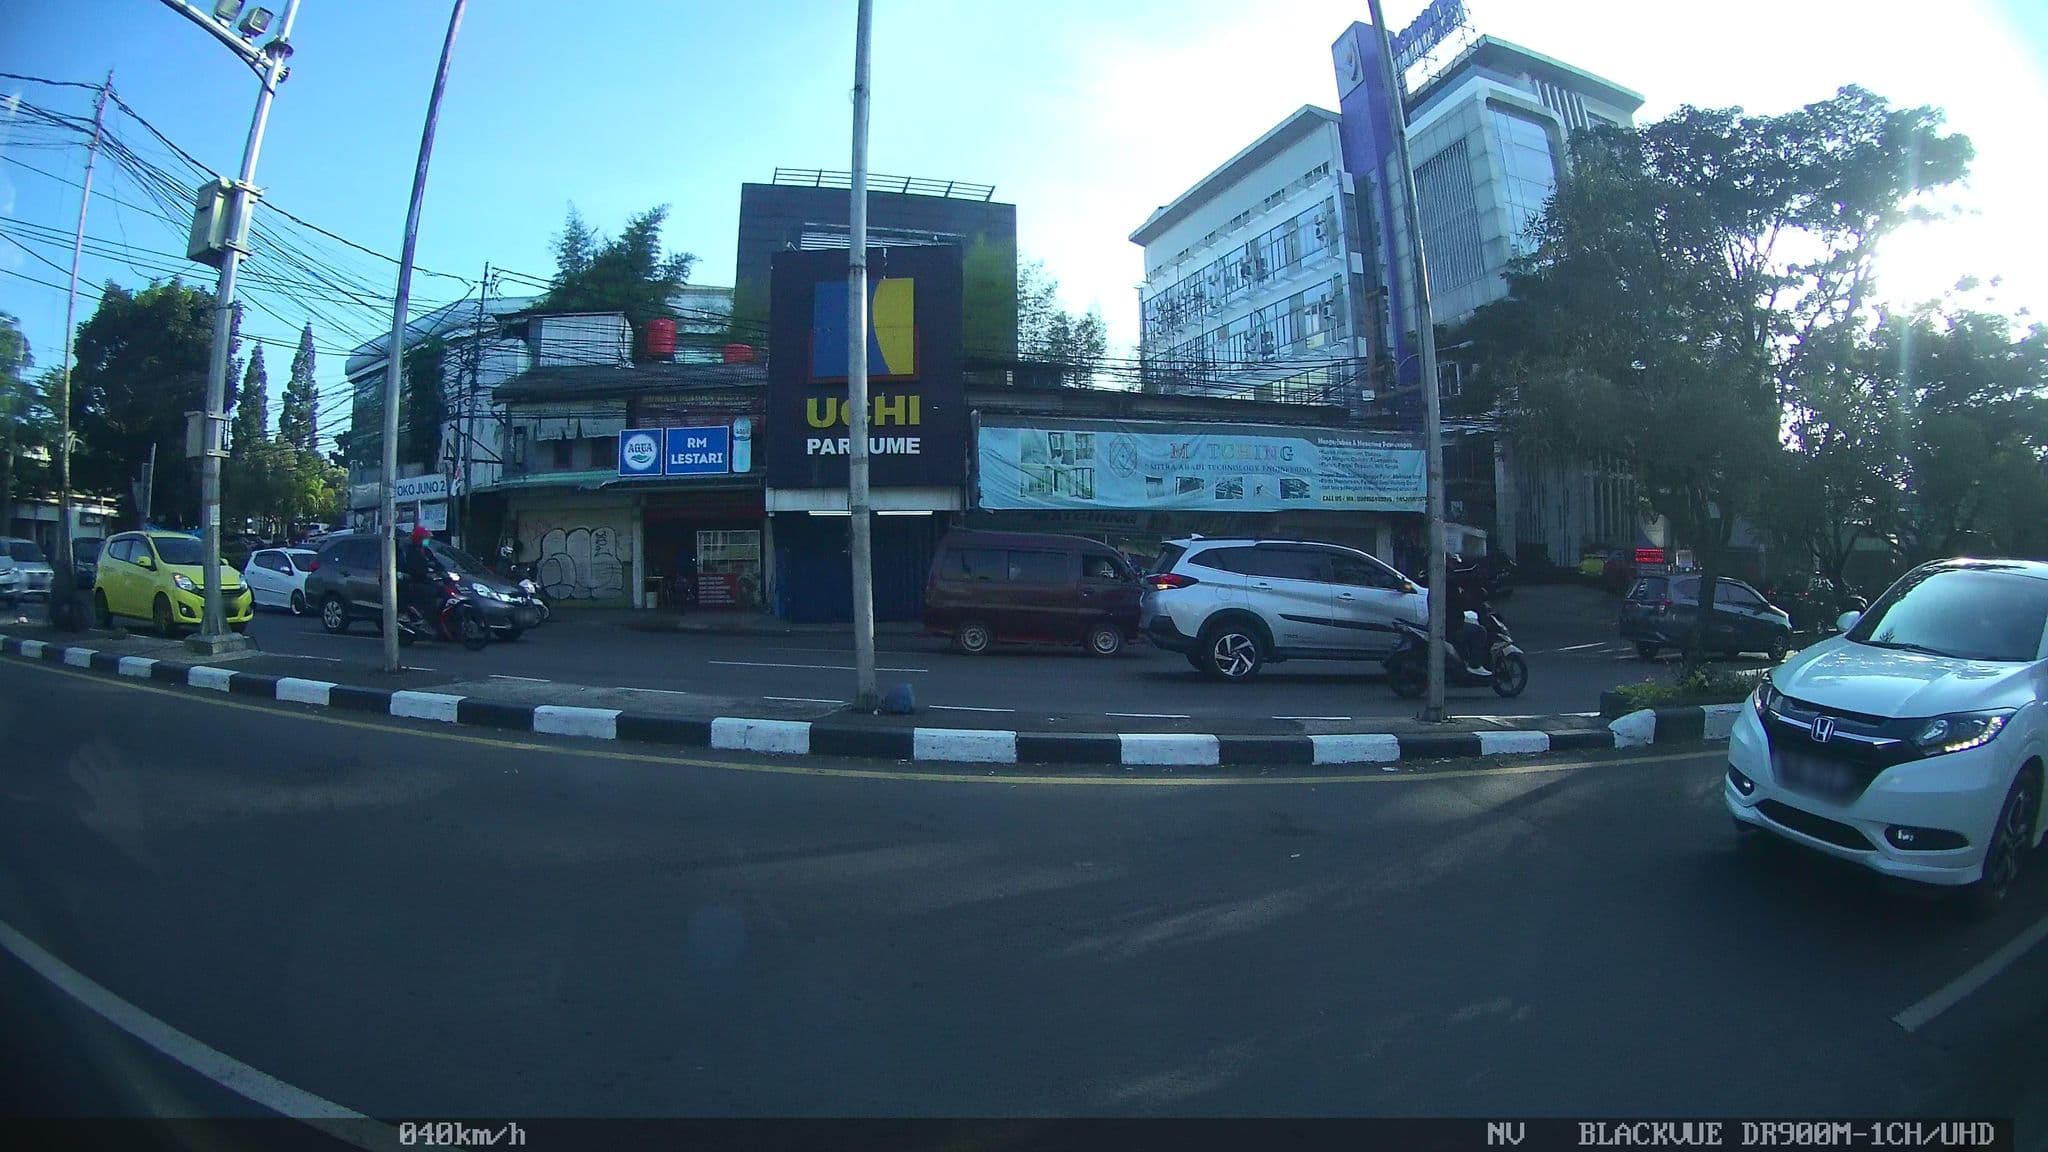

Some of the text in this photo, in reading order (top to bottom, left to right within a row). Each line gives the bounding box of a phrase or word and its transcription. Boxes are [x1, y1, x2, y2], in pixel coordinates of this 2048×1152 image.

[627, 442, 653, 455] AQUA
[687, 437, 707, 448] RM
[807, 437, 921, 455] PARUME
[671, 452, 723, 465] LESTARI
[397, 480, 446, 496] OKO JUNO 2
